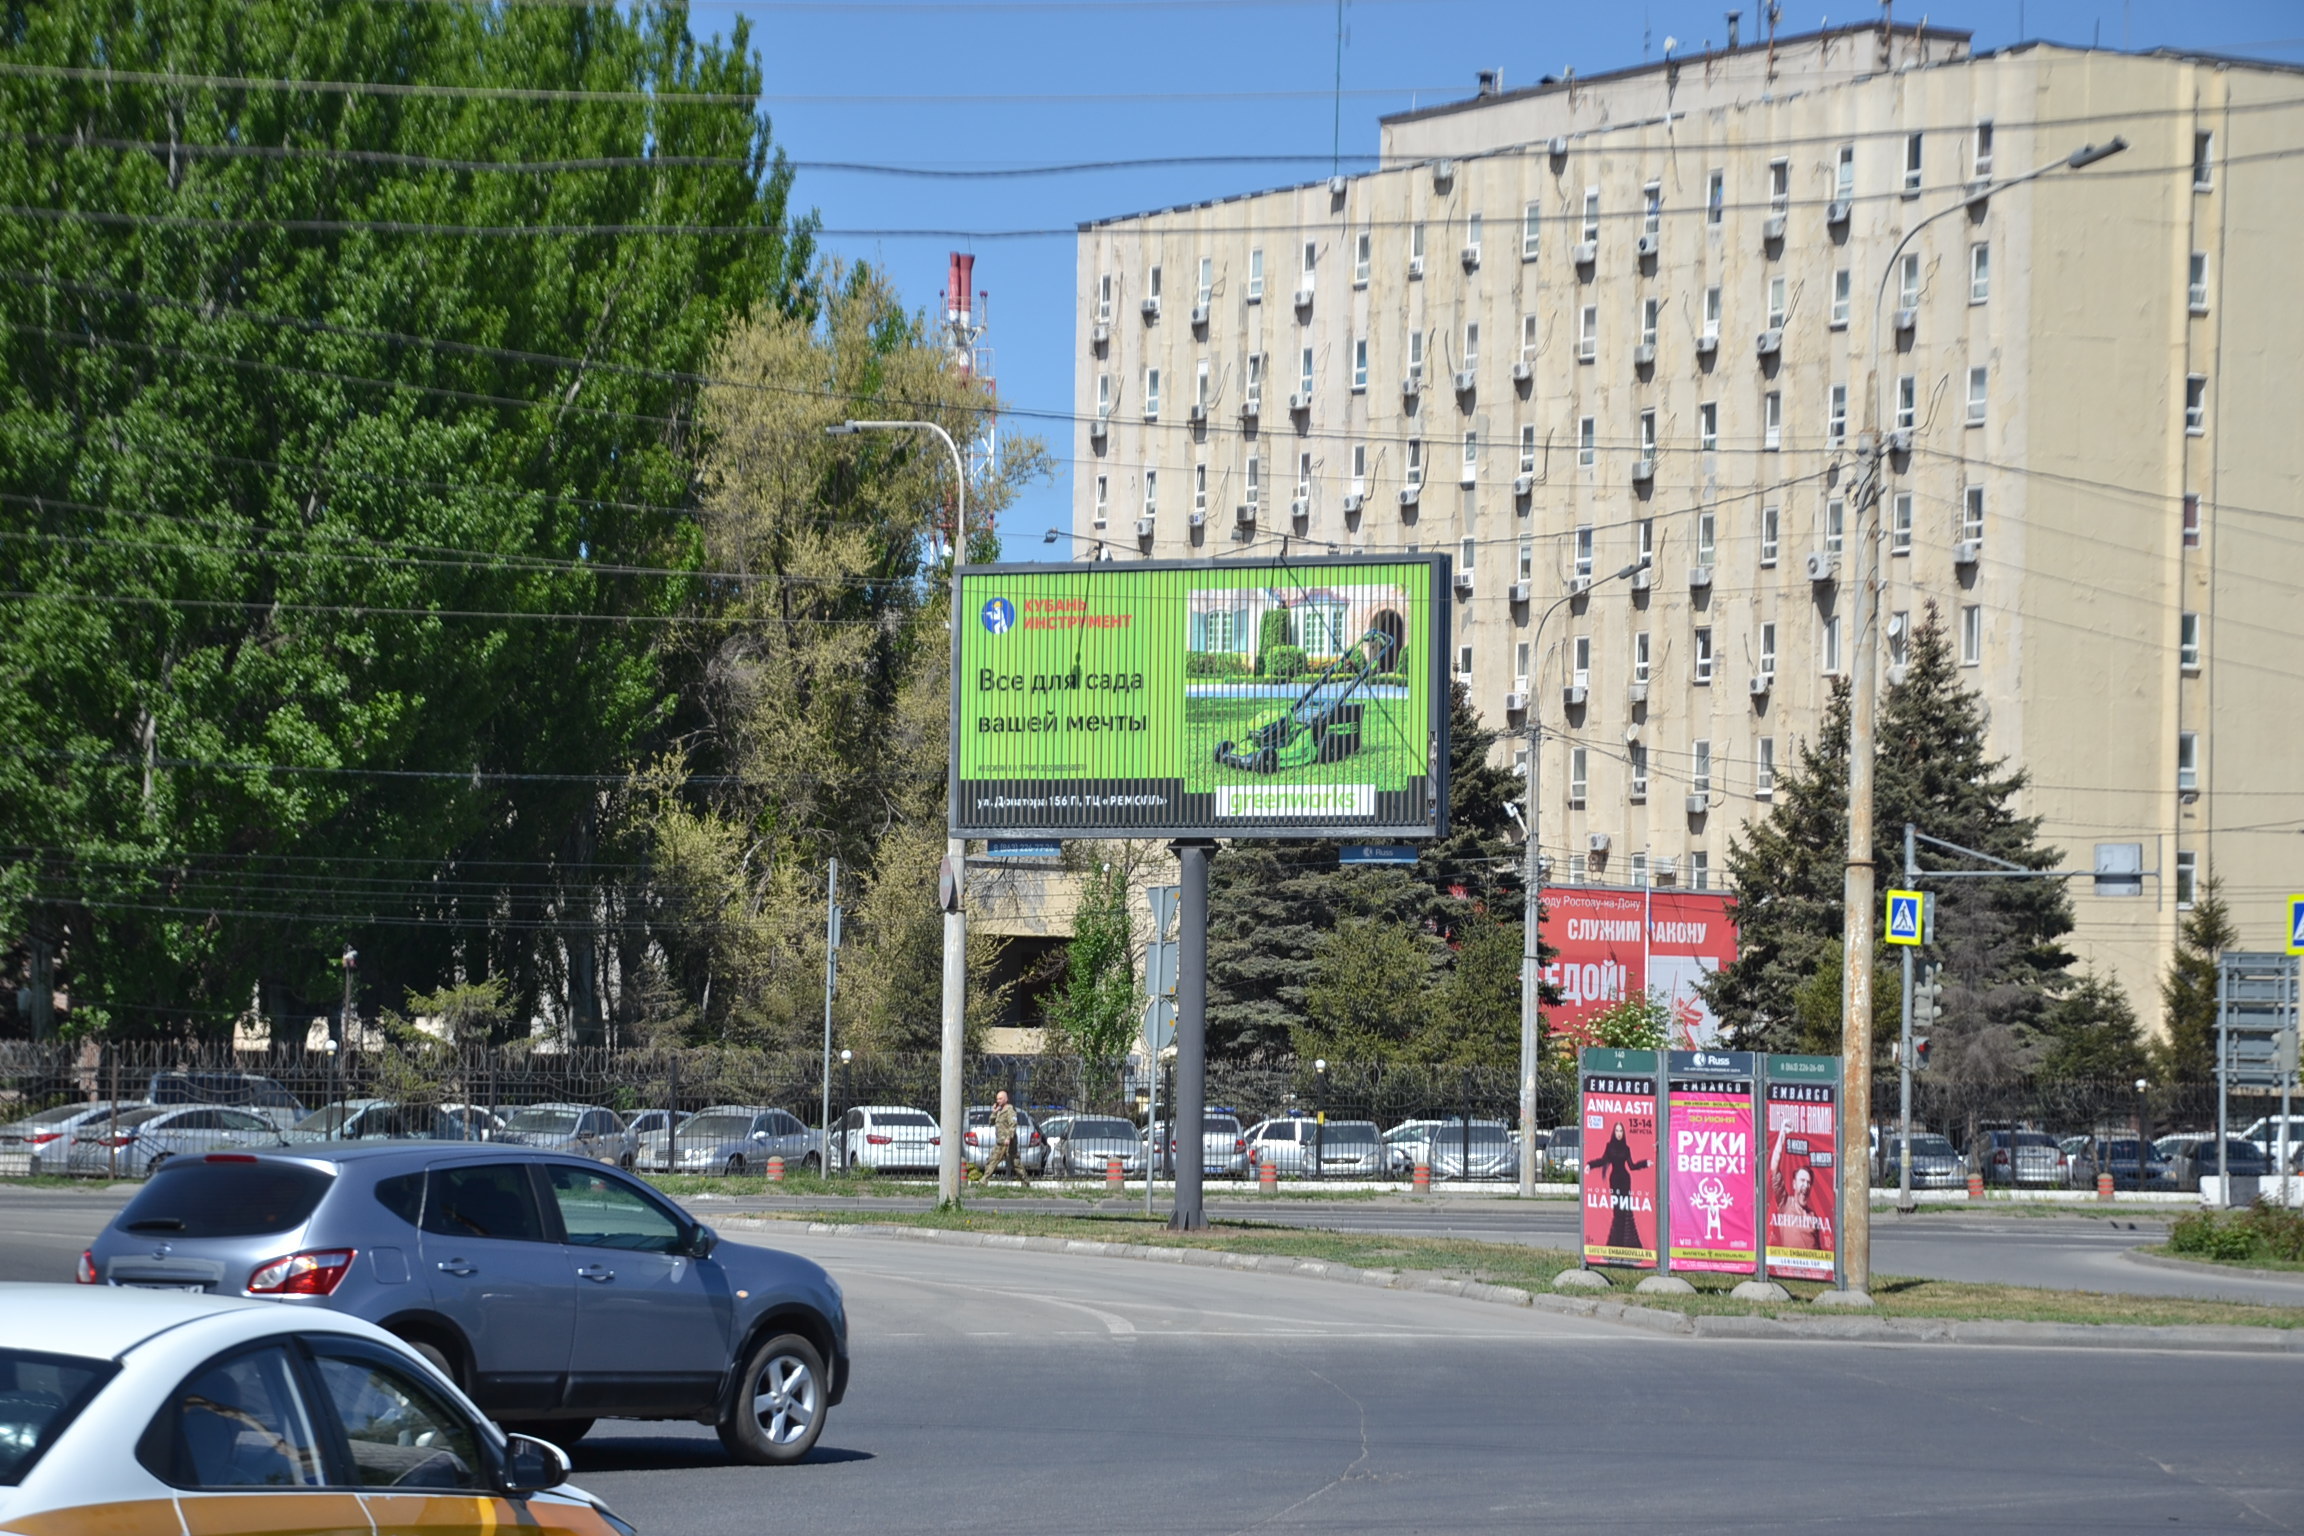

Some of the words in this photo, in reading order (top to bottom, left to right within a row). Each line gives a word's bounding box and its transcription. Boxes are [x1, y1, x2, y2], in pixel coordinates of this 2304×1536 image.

[1024, 598, 1088, 612] КУБАНЬ
[1024, 614, 1132, 630] ИНСТРУМЕНТ
[980, 668, 1024, 691] Все
[1032, 674, 1078, 694] для
[1086, 673, 1144, 693] сада
[978, 710, 1057, 733] вашей
[1066, 715, 1147, 732] мечты
[977, 798, 993, 809] ул.
[1049, 795, 1068, 807] 156
[1085, 795, 1100, 808] ТЦ
[1231, 787, 1357, 815] greenworks
[1375, 848, 1393, 857] Russ
[1563, 896, 1641, 912] Ростову-на-Дону
[1568, 918, 1640, 942] СЛУЖИМ
[1708, 1055, 1730, 1066] Russ
[1590, 1079, 1649, 1094] EMBARGO
[1772, 1086, 1829, 1102] EMBARGO
[1587, 1098, 1623, 1114] ANNA
[1624, 1100, 1653, 1115] ASTI
[1629, 1118, 1652, 1128] 13-14
[1677, 1130, 1746, 1156] РУКИ
[1677, 1154, 1746, 1175] ВВЕРХ!
[1587, 1193, 1652, 1212] ЦАРИЦА
[1770, 1213, 1832, 1234] ЛЕНИНГРАД
